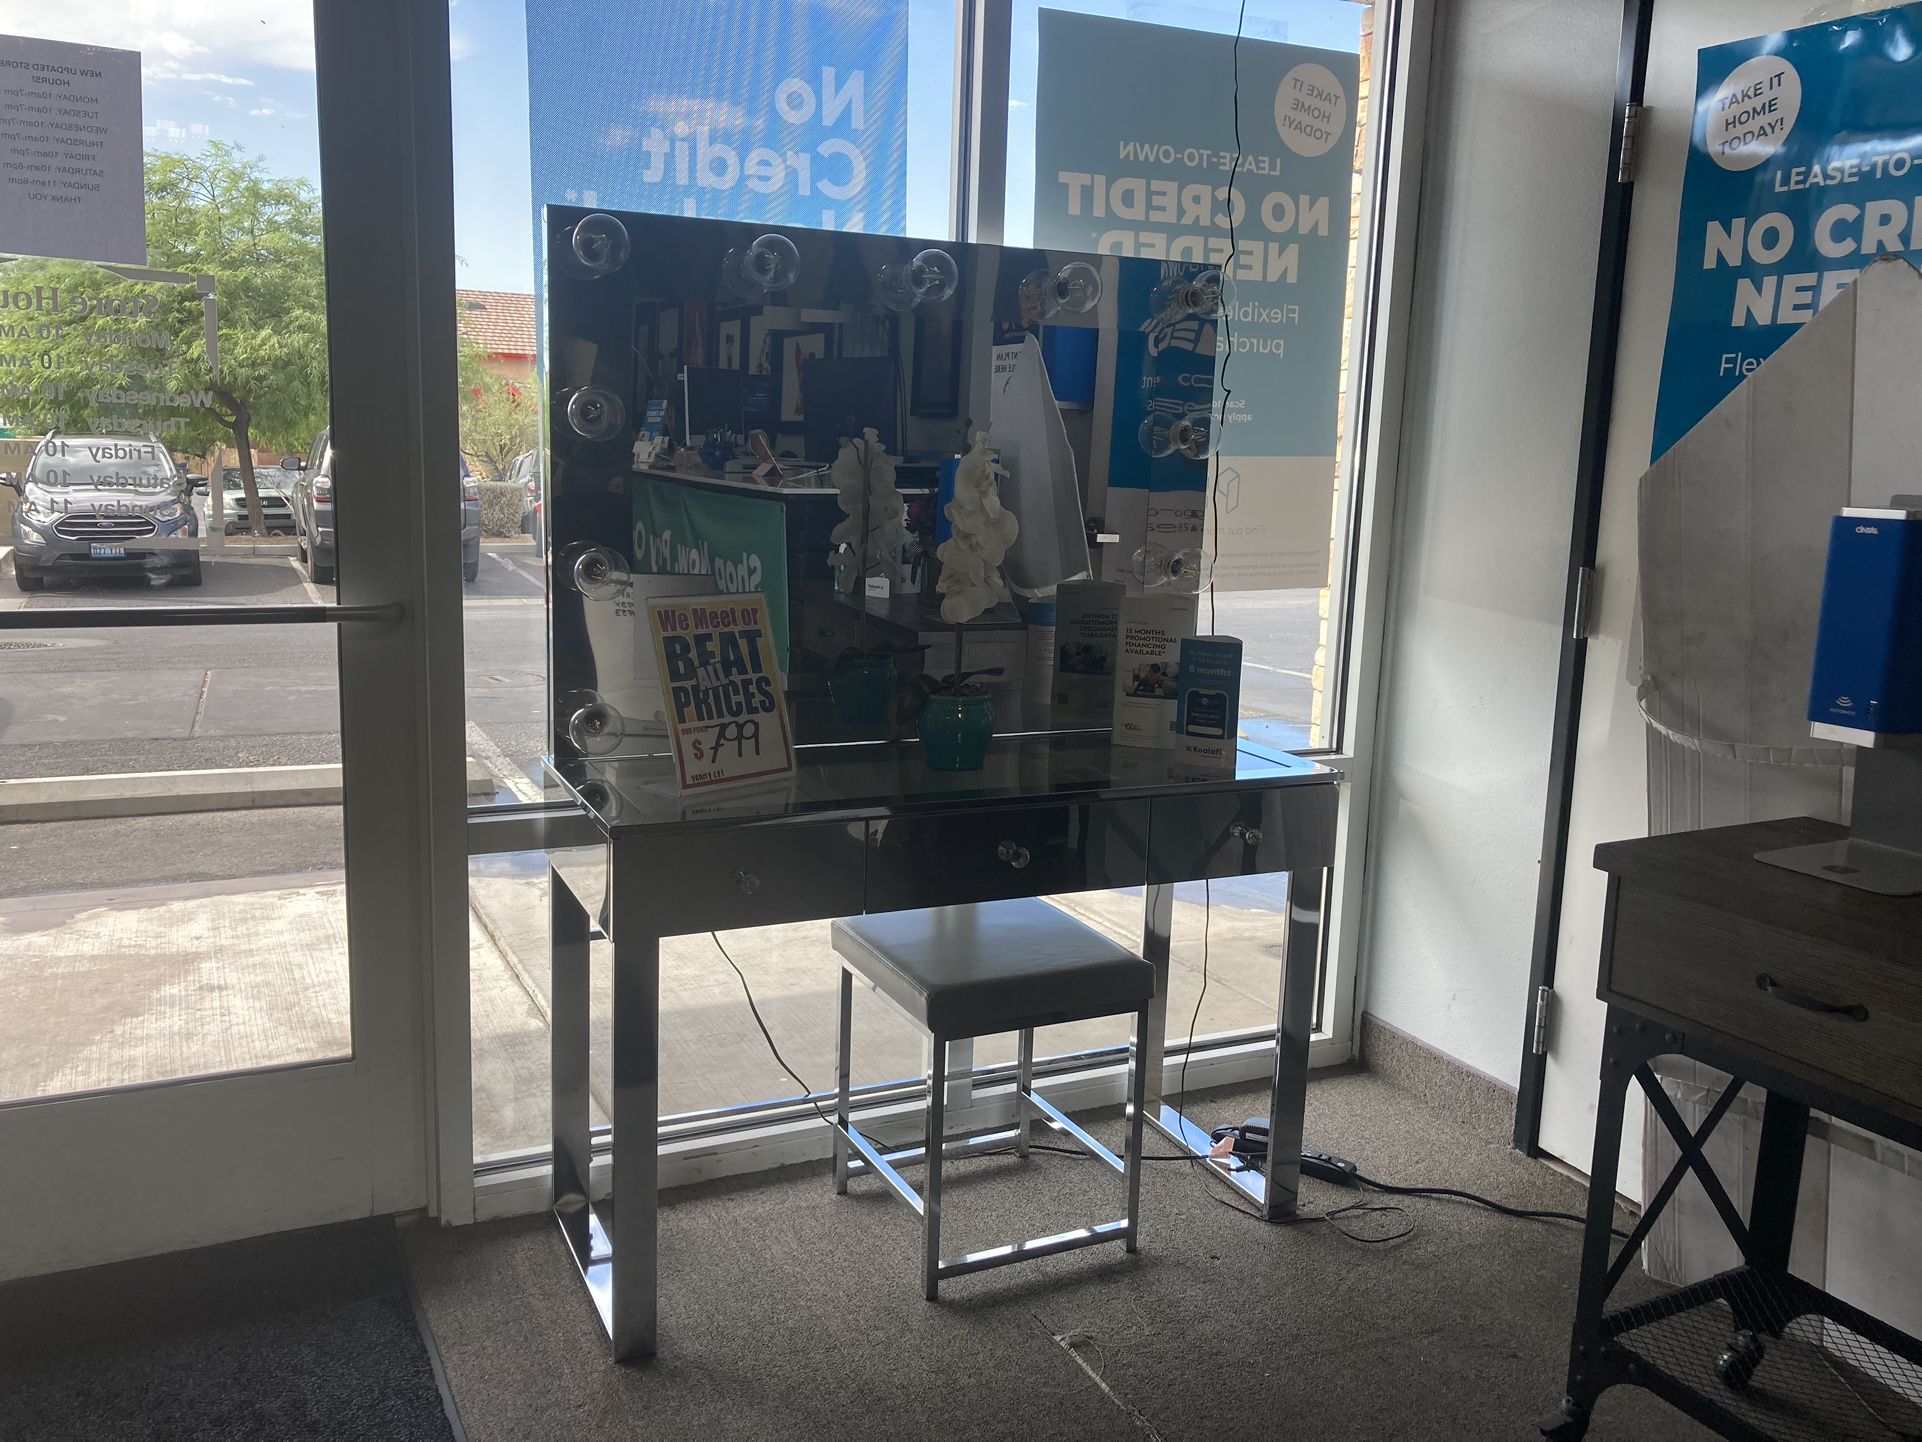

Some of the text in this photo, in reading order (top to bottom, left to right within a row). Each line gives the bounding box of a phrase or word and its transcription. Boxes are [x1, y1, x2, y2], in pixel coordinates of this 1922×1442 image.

[1720, 71, 1786, 113] TAKE IT
[1724, 97, 1779, 132] HOME
[1717, 117, 1785, 156] TODAY!
[1703, 211, 1794, 270] NO
[656, 606, 759, 633] We Meet or
[1125, 627, 1165, 637] 12 MONTHS
[1125, 634, 1178, 644] PROMOTIONAL
[1125, 641, 1167, 650] FINANCING
[662, 629, 764, 683] BEAT
[1197, 667, 1232, 677] months
[696, 662, 730, 691] ALL
[671, 675, 776, 725] PRICES
